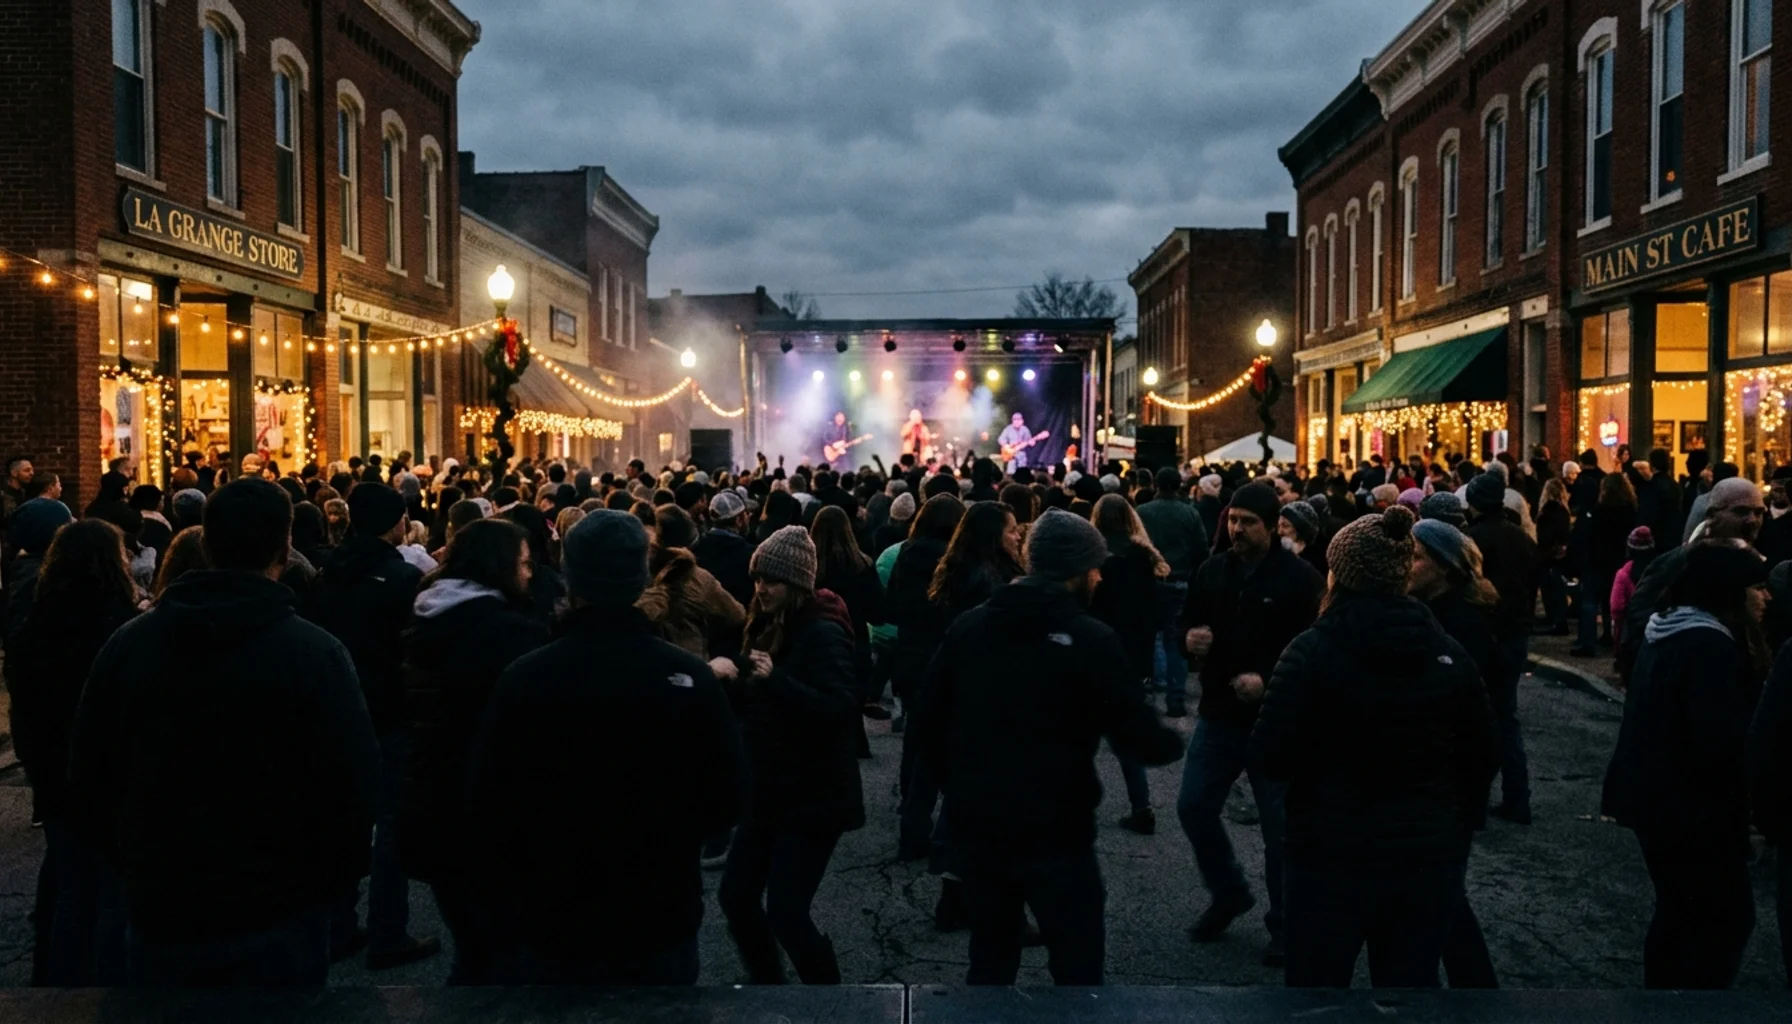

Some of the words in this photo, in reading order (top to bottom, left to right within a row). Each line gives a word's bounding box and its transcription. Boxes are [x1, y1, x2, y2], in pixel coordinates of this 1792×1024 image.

[134, 197, 163, 234] LA
[168, 210, 244, 258] GRANGE
[248, 235, 298, 274] STORE
[1585, 243, 1640, 288] MAIN
[1645, 232, 1675, 269] ST
[1681, 207, 1751, 259] CAFE
